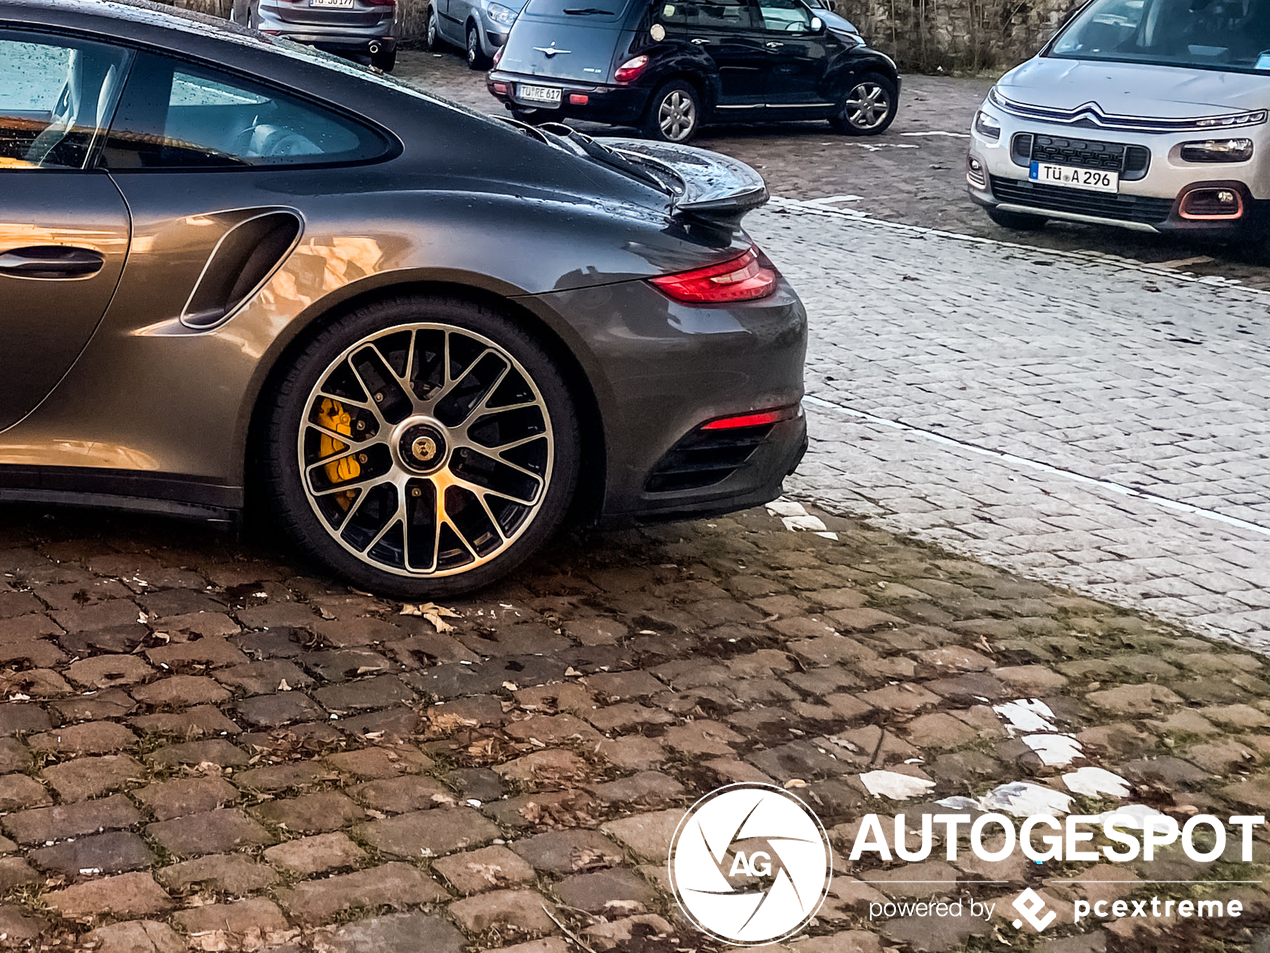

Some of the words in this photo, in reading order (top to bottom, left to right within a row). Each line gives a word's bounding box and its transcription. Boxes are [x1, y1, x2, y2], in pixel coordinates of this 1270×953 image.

[534, 87, 546, 98] RE
[546, 88, 561, 100] 617
[1043, 165, 1062, 181] TÜ
[1071, 169, 1080, 184] A
[1083, 171, 1111, 187] 296
